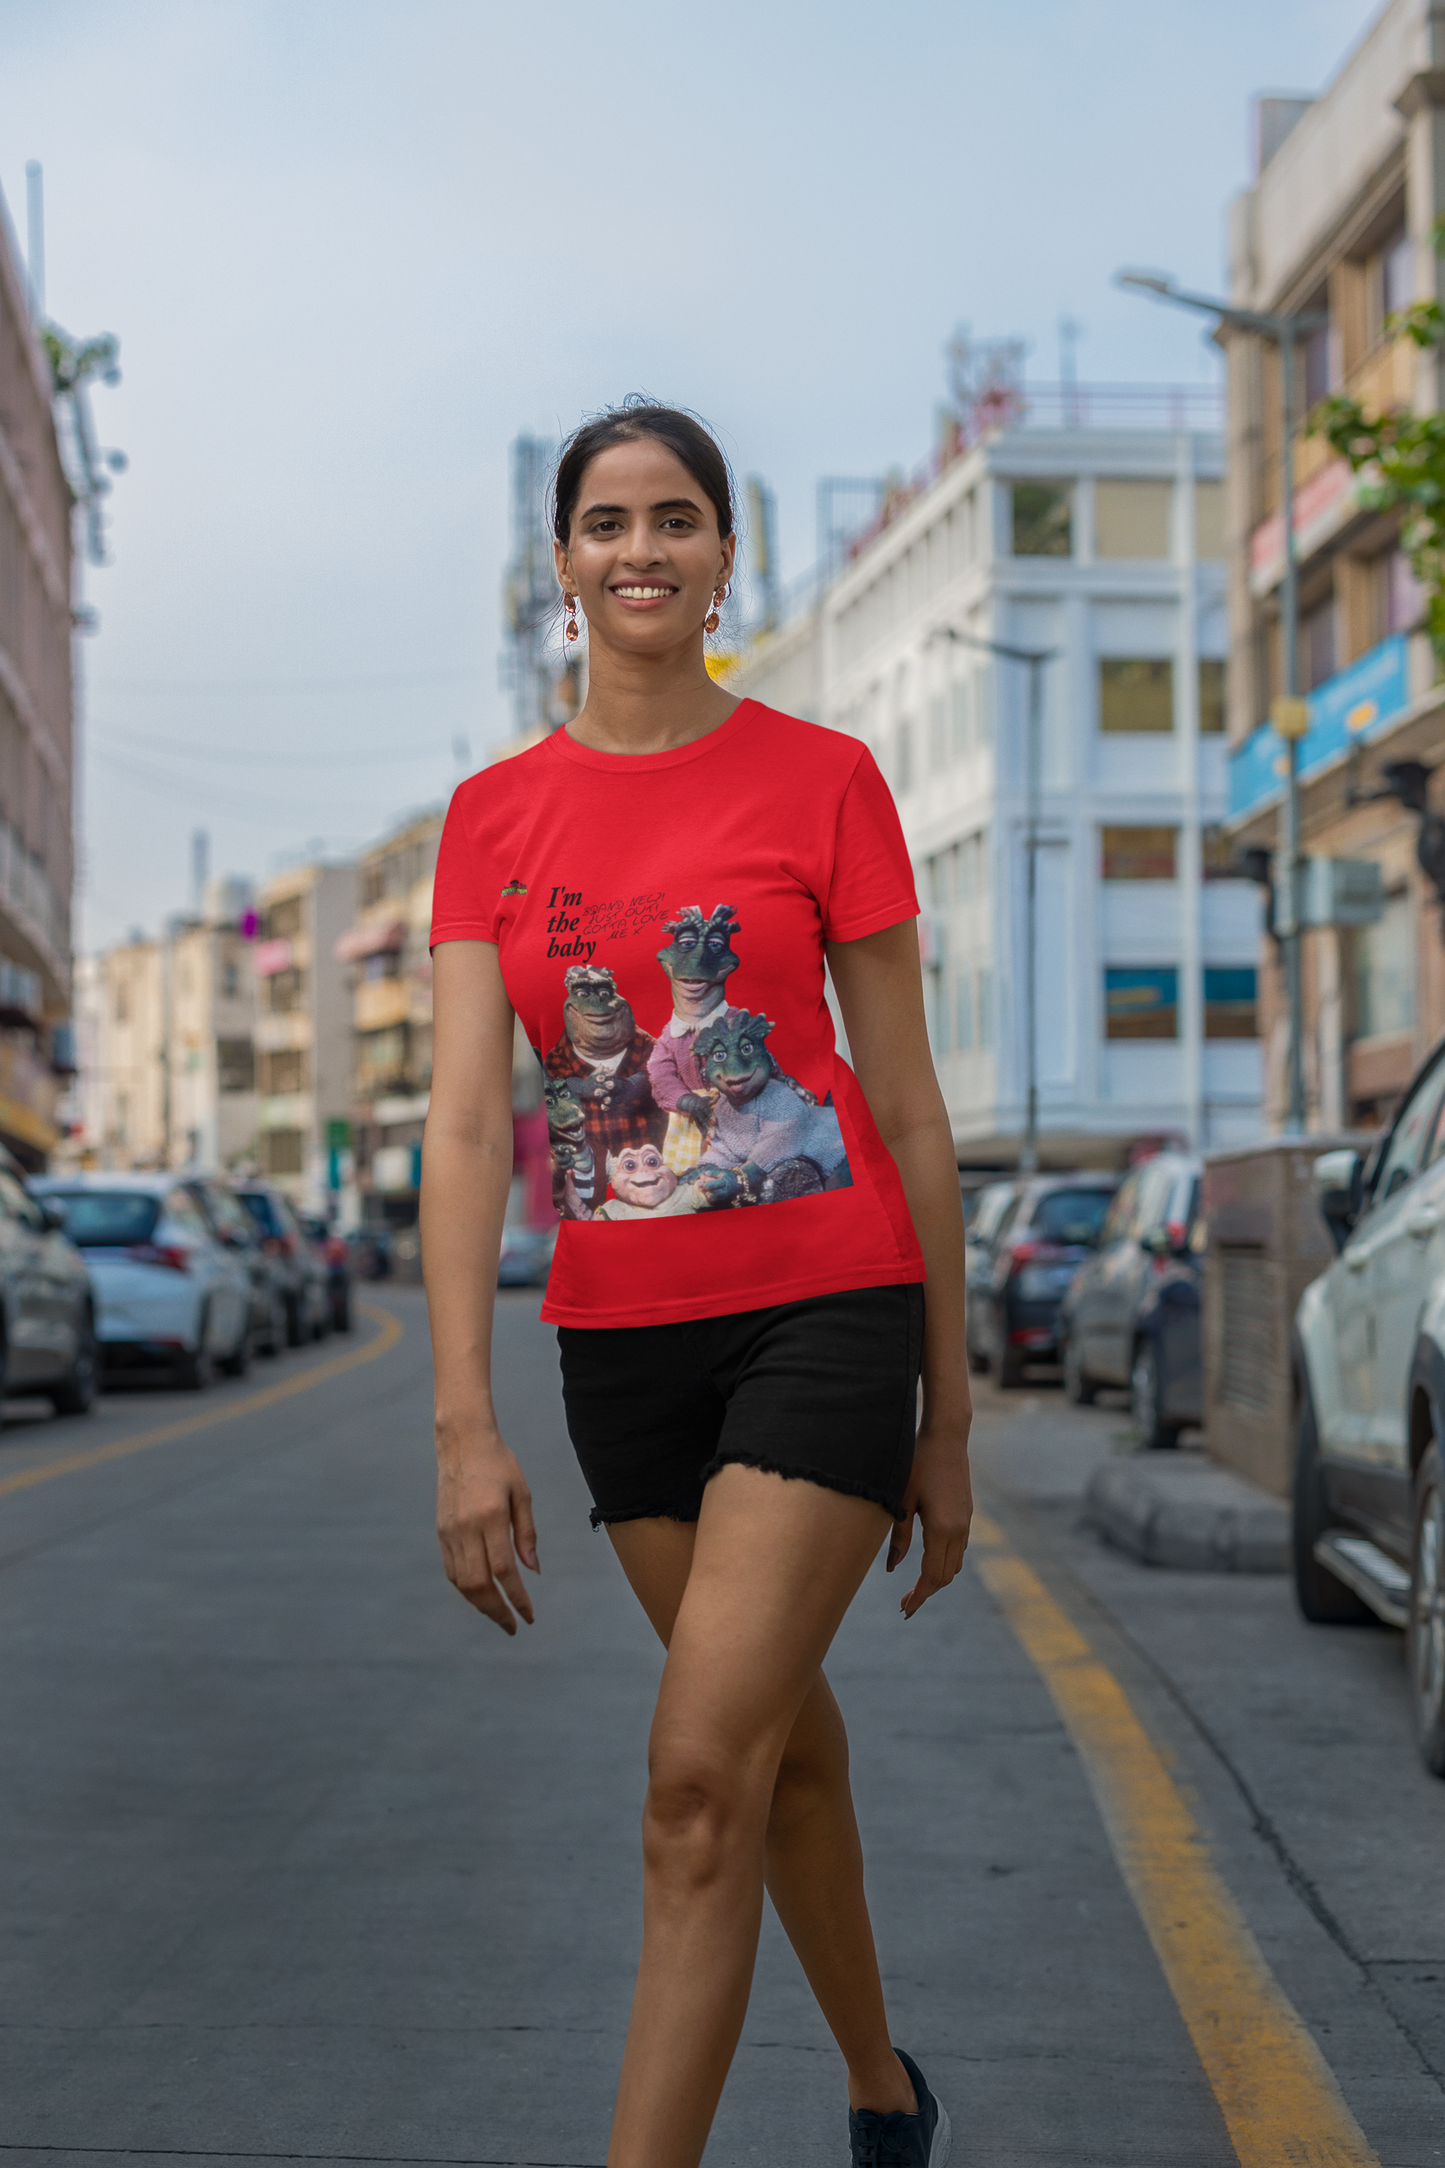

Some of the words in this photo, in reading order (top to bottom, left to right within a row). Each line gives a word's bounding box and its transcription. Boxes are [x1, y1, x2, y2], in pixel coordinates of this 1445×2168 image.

[546, 886, 583, 909] I'm
[582, 900, 625, 917] BRAND
[630, 892, 666, 907] NEW!
[547, 911, 580, 933] the
[583, 918, 627, 935] GOTTA
[633, 910, 670, 926] LOVE
[588, 908, 623, 924] JUST
[625, 902, 659, 917] OUT!
[606, 928, 629, 942] ME
[547, 935, 596, 964] baby
